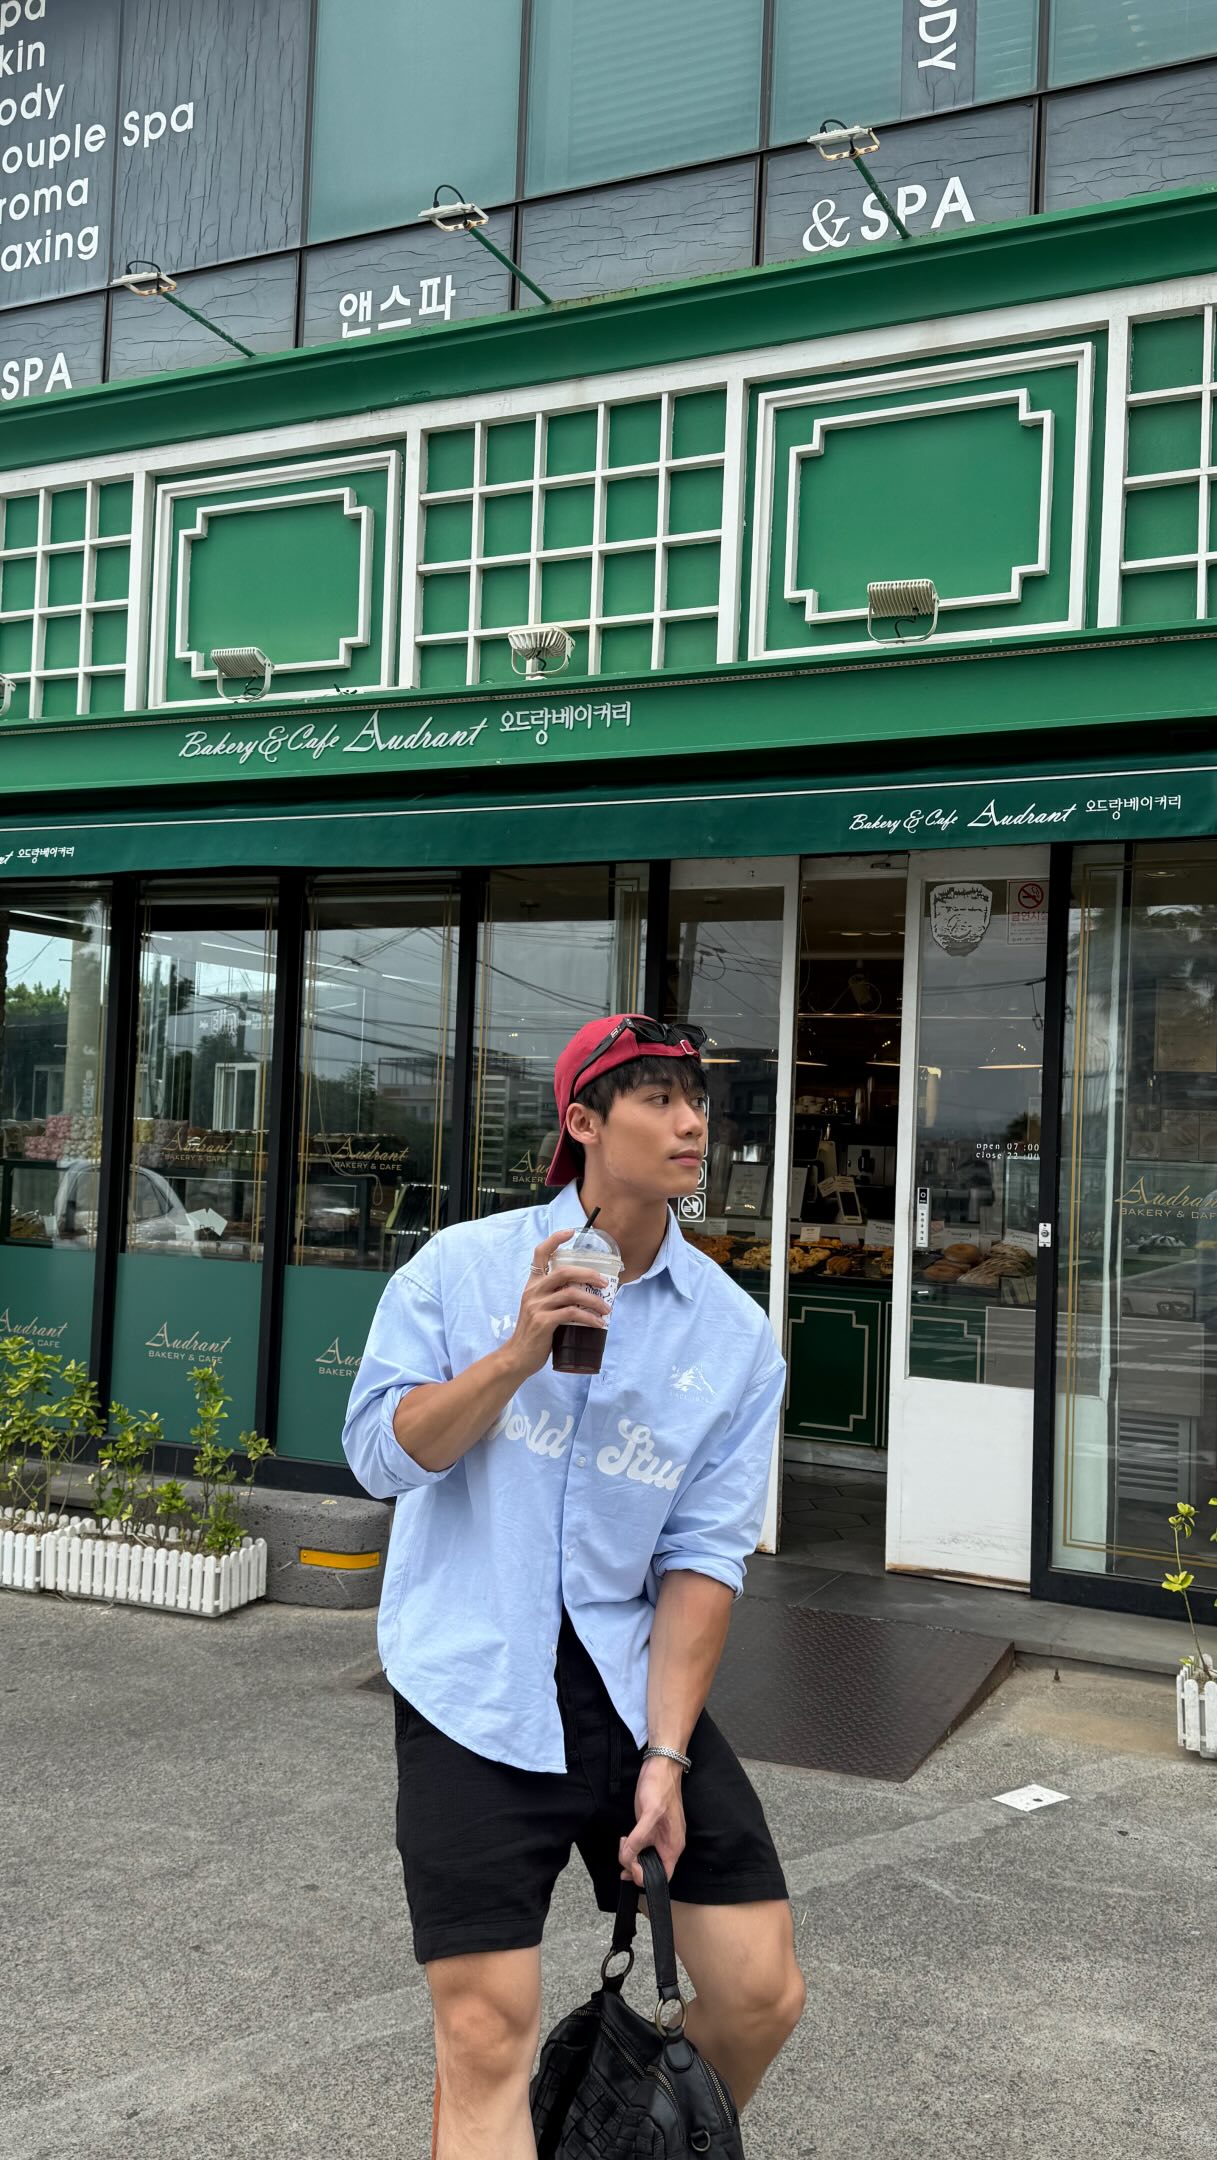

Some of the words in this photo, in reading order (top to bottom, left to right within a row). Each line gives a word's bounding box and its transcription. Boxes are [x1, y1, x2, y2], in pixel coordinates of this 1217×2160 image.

[918, 0, 957, 70] DY
[1, 123, 107, 174] ouple
[122, 102, 194, 148] Spa
[802, 199, 850, 252] &
[860, 176, 976, 241] SPA
[1, 225, 99, 272] axing
[339, 274, 457, 338] 앤스파
[1, 352, 73, 400] SPA
[342, 709, 489, 752] Audrant
[499, 700, 632, 746] 오드랑베이커리
[849, 813, 901, 834] Bakery
[925, 808, 959, 831] Cafe
[967, 798, 1078, 827] Audrant
[1085, 794, 1182, 821] 오드랑베이커리
[17, 846, 75, 864] 오드랑베이커리
[331, 1136, 409, 1162] Audrant
[379, 1163, 402, 1171] CAFE
[1120, 1208, 1172, 1218] BAKERY
[1176, 1210, 1185, 1219] &
[37, 1339, 61, 1348] CAFE
[145, 1321, 233, 1353] Audrant
[148, 1350, 186, 1361] BAKERY
